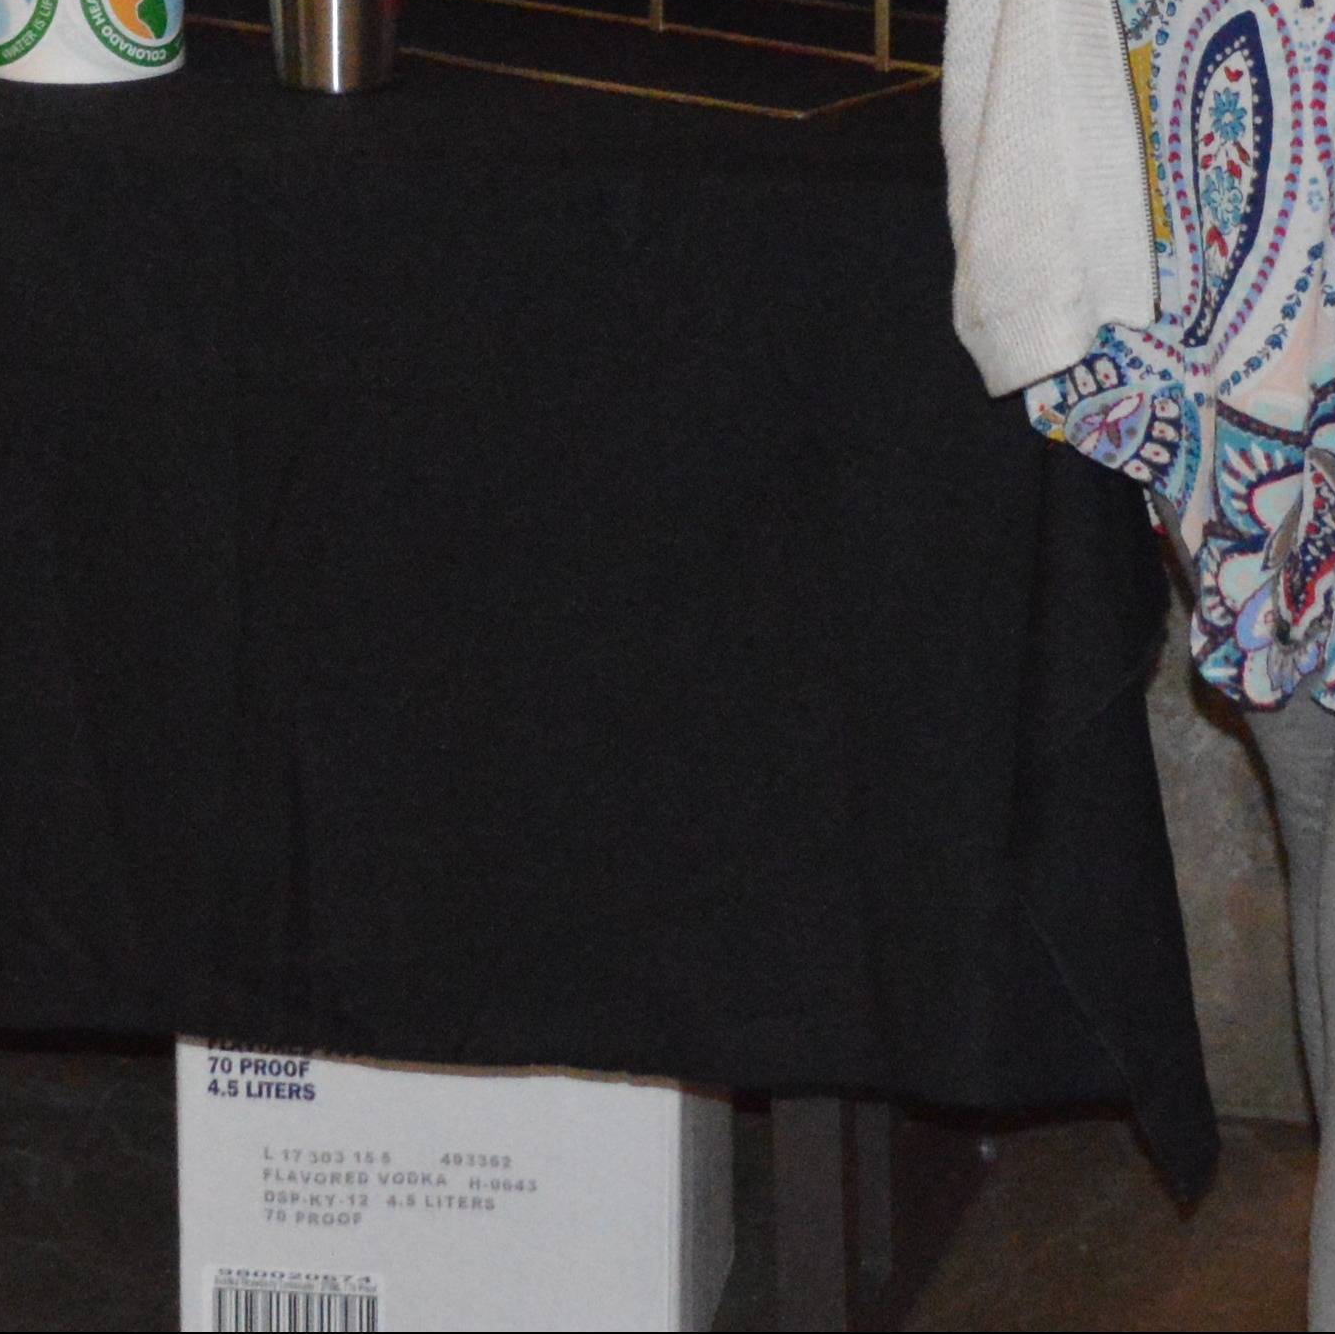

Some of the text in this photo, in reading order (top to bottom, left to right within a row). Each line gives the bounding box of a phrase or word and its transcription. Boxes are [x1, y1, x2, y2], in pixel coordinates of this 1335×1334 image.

[101, 26, 167, 61] COLORADO
[207, 1056, 311, 1078] 70 PROOF
[207, 1079, 316, 1101] 4.5 LITERS
[262, 1167, 369, 1186] FLAVORED
[377, 1171, 448, 1188] VODKA
[425, 1196, 496, 1211] LITERS
[295, 1210, 363, 1226] PROOF
